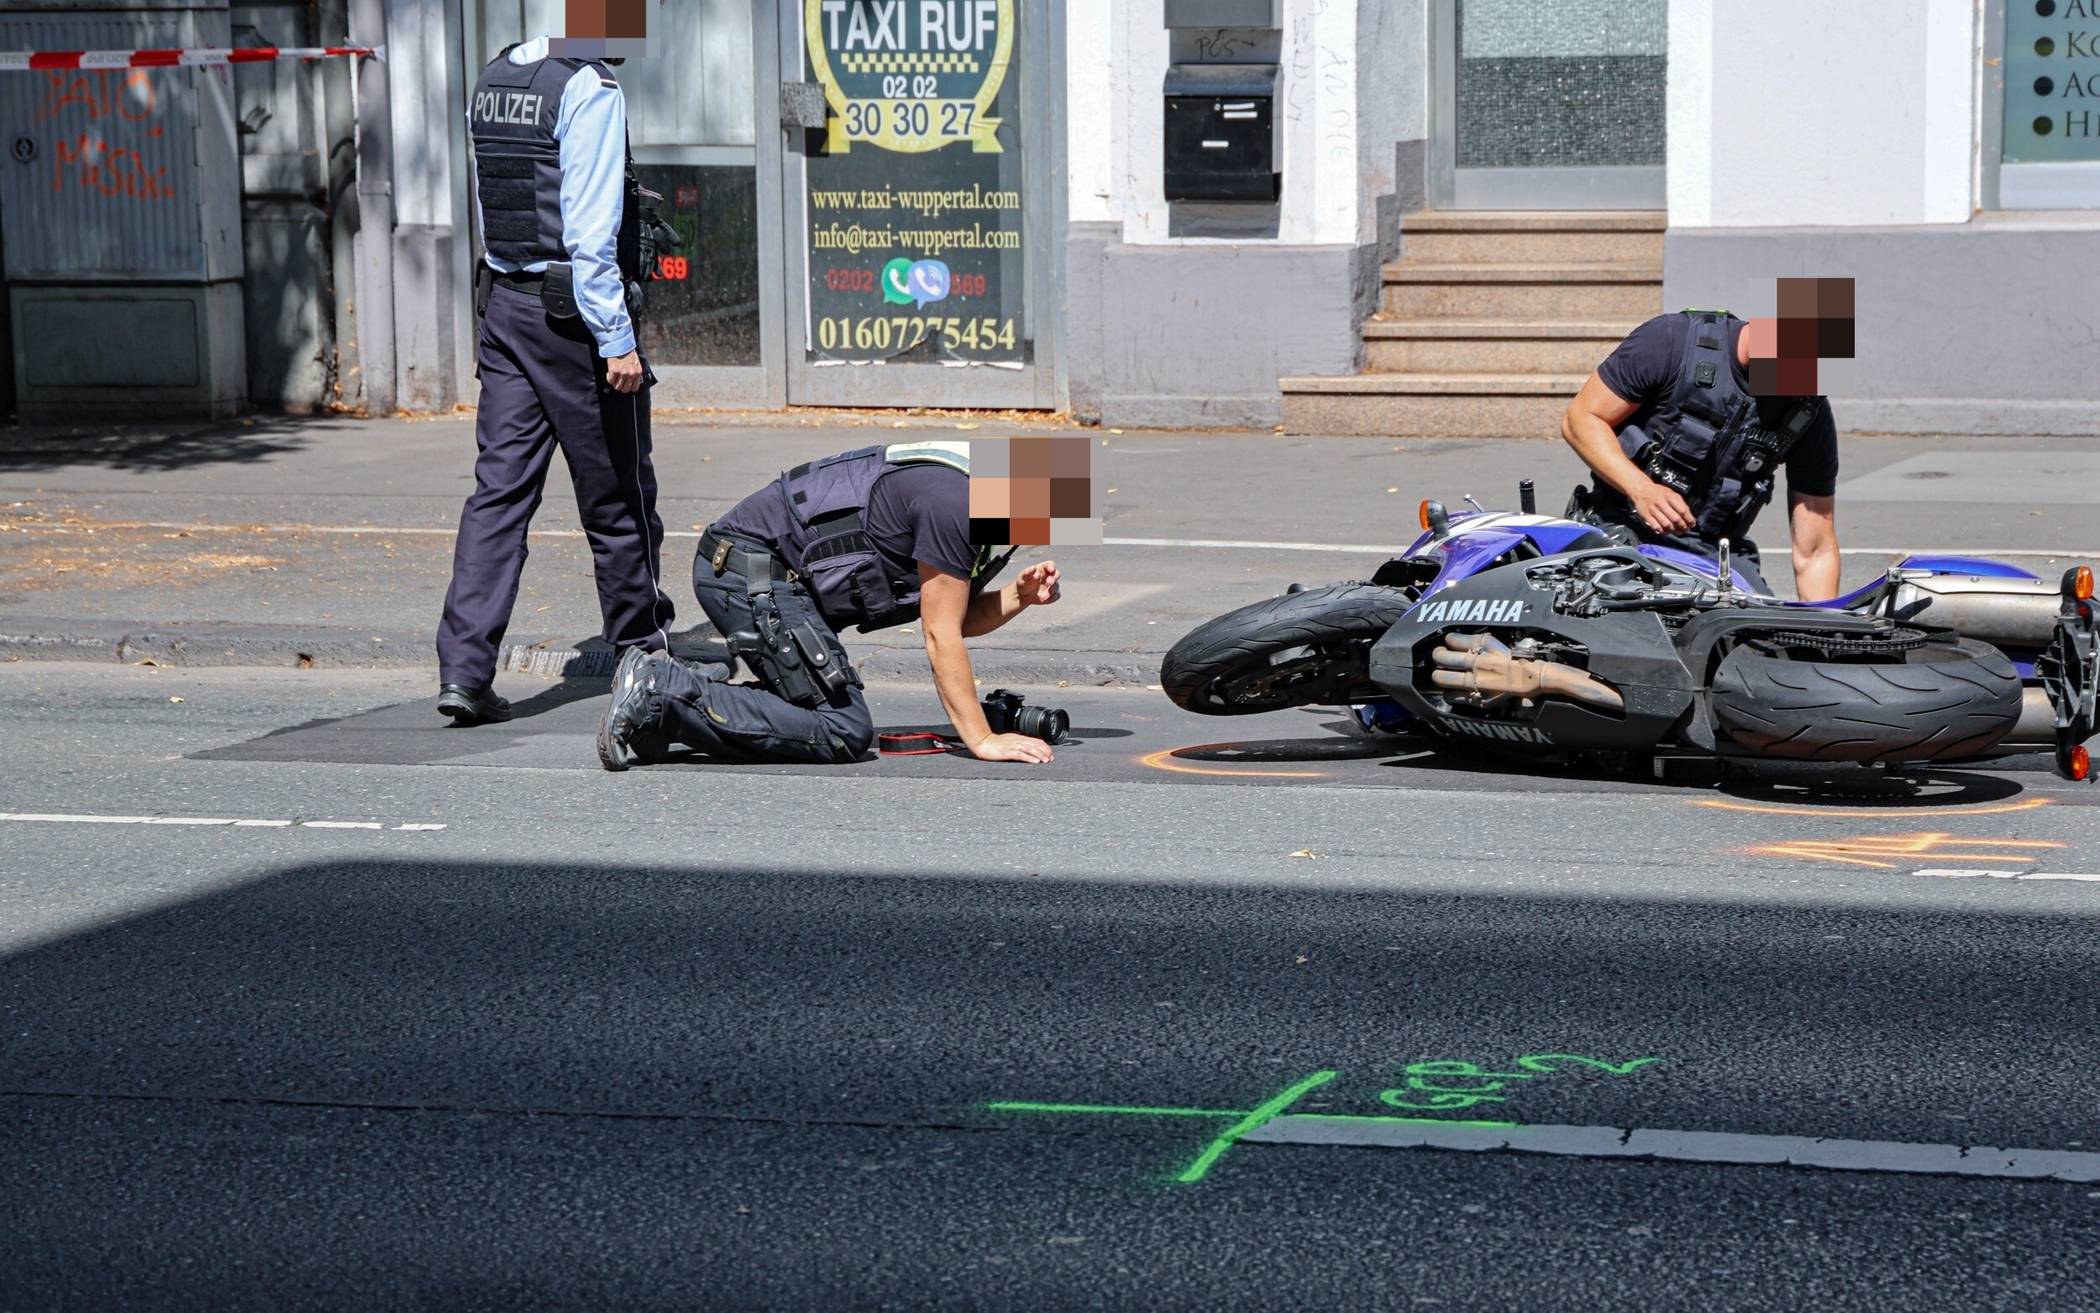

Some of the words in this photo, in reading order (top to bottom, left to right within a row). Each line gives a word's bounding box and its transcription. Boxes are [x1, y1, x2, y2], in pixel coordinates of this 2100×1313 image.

[822, 0, 906, 50] TAXI
[920, 0, 997, 50] RUF
[882, 75, 907, 99] 02
[912, 75, 938, 99] 02
[473, 91, 543, 126] POLIZEI
[845, 102, 881, 136] 30
[892, 102, 929, 136] 30
[940, 102, 976, 136] 27
[812, 184, 1019, 216] www.taxi-wuppertal.com
[814, 222, 1020, 255] info@taxi-wuppertal.com
[1416, 600, 1524, 622] YAMAHA
[1438, 716, 1554, 744] YAMAHA
